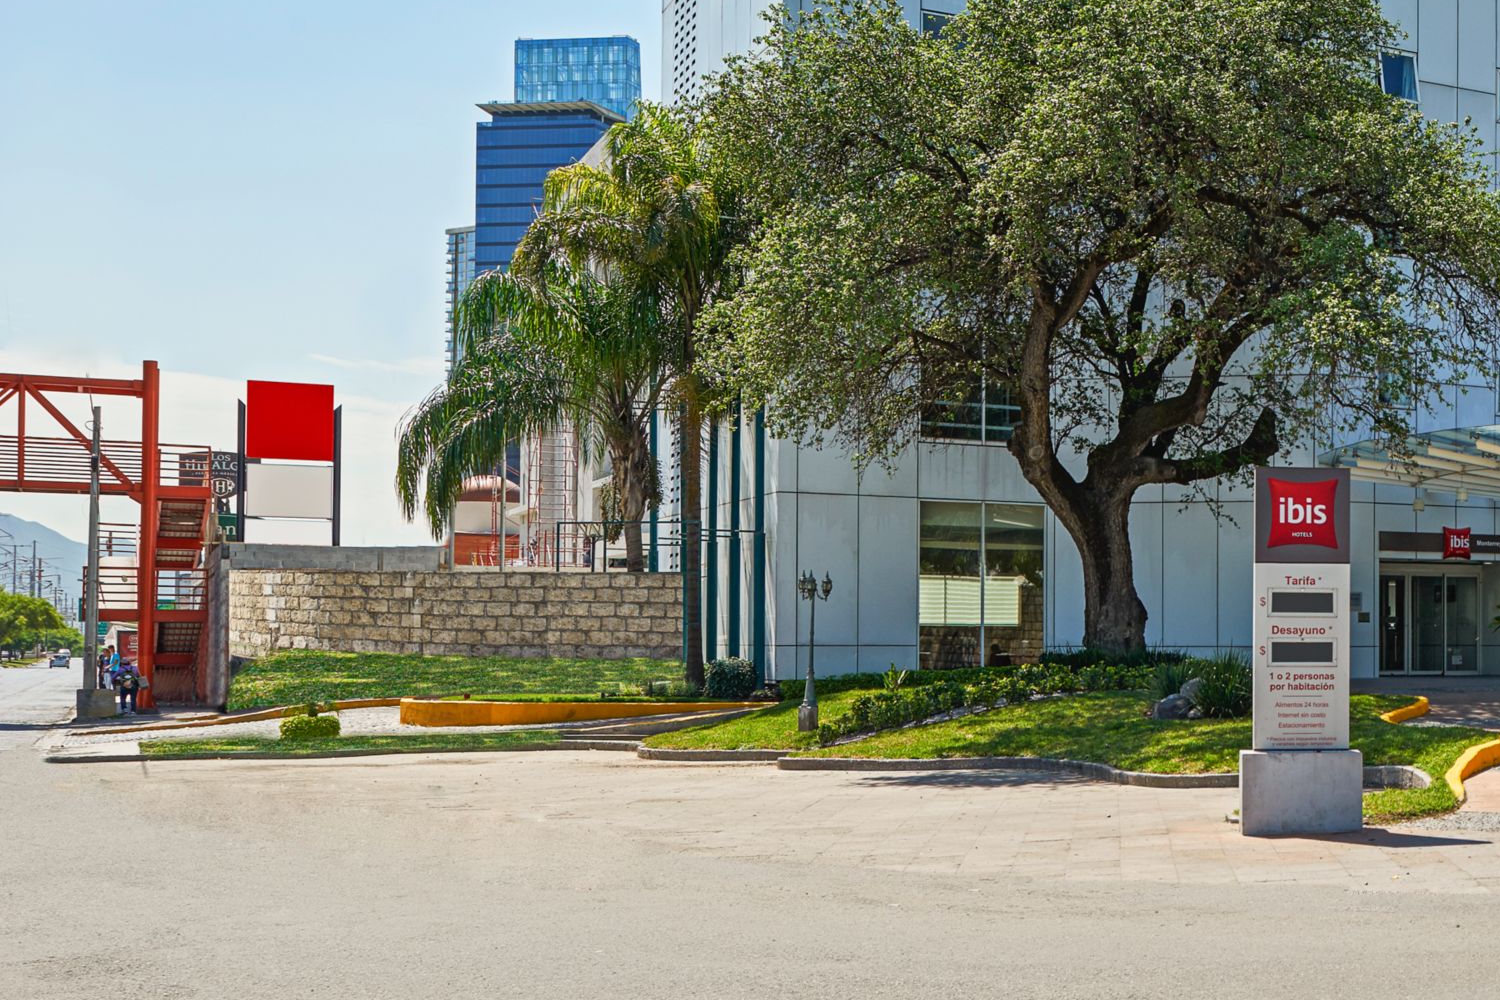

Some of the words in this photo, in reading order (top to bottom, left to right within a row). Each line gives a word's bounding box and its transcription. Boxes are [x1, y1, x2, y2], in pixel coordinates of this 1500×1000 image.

[211, 453, 231, 461] LOS
[215, 480, 226, 493] H
[1279, 497, 1327, 524] ibis
[1450, 535, 1470, 548] ibis
[1284, 575, 1316, 585] Tarifa
[1271, 625, 1326, 637] Desayuno
[1269, 672, 1274, 680] 1
[1285, 672, 1291, 680] 2
[1293, 673, 1335, 681] personas
[1269, 683, 1286, 692] por
[1287, 682, 1335, 691] habitación
